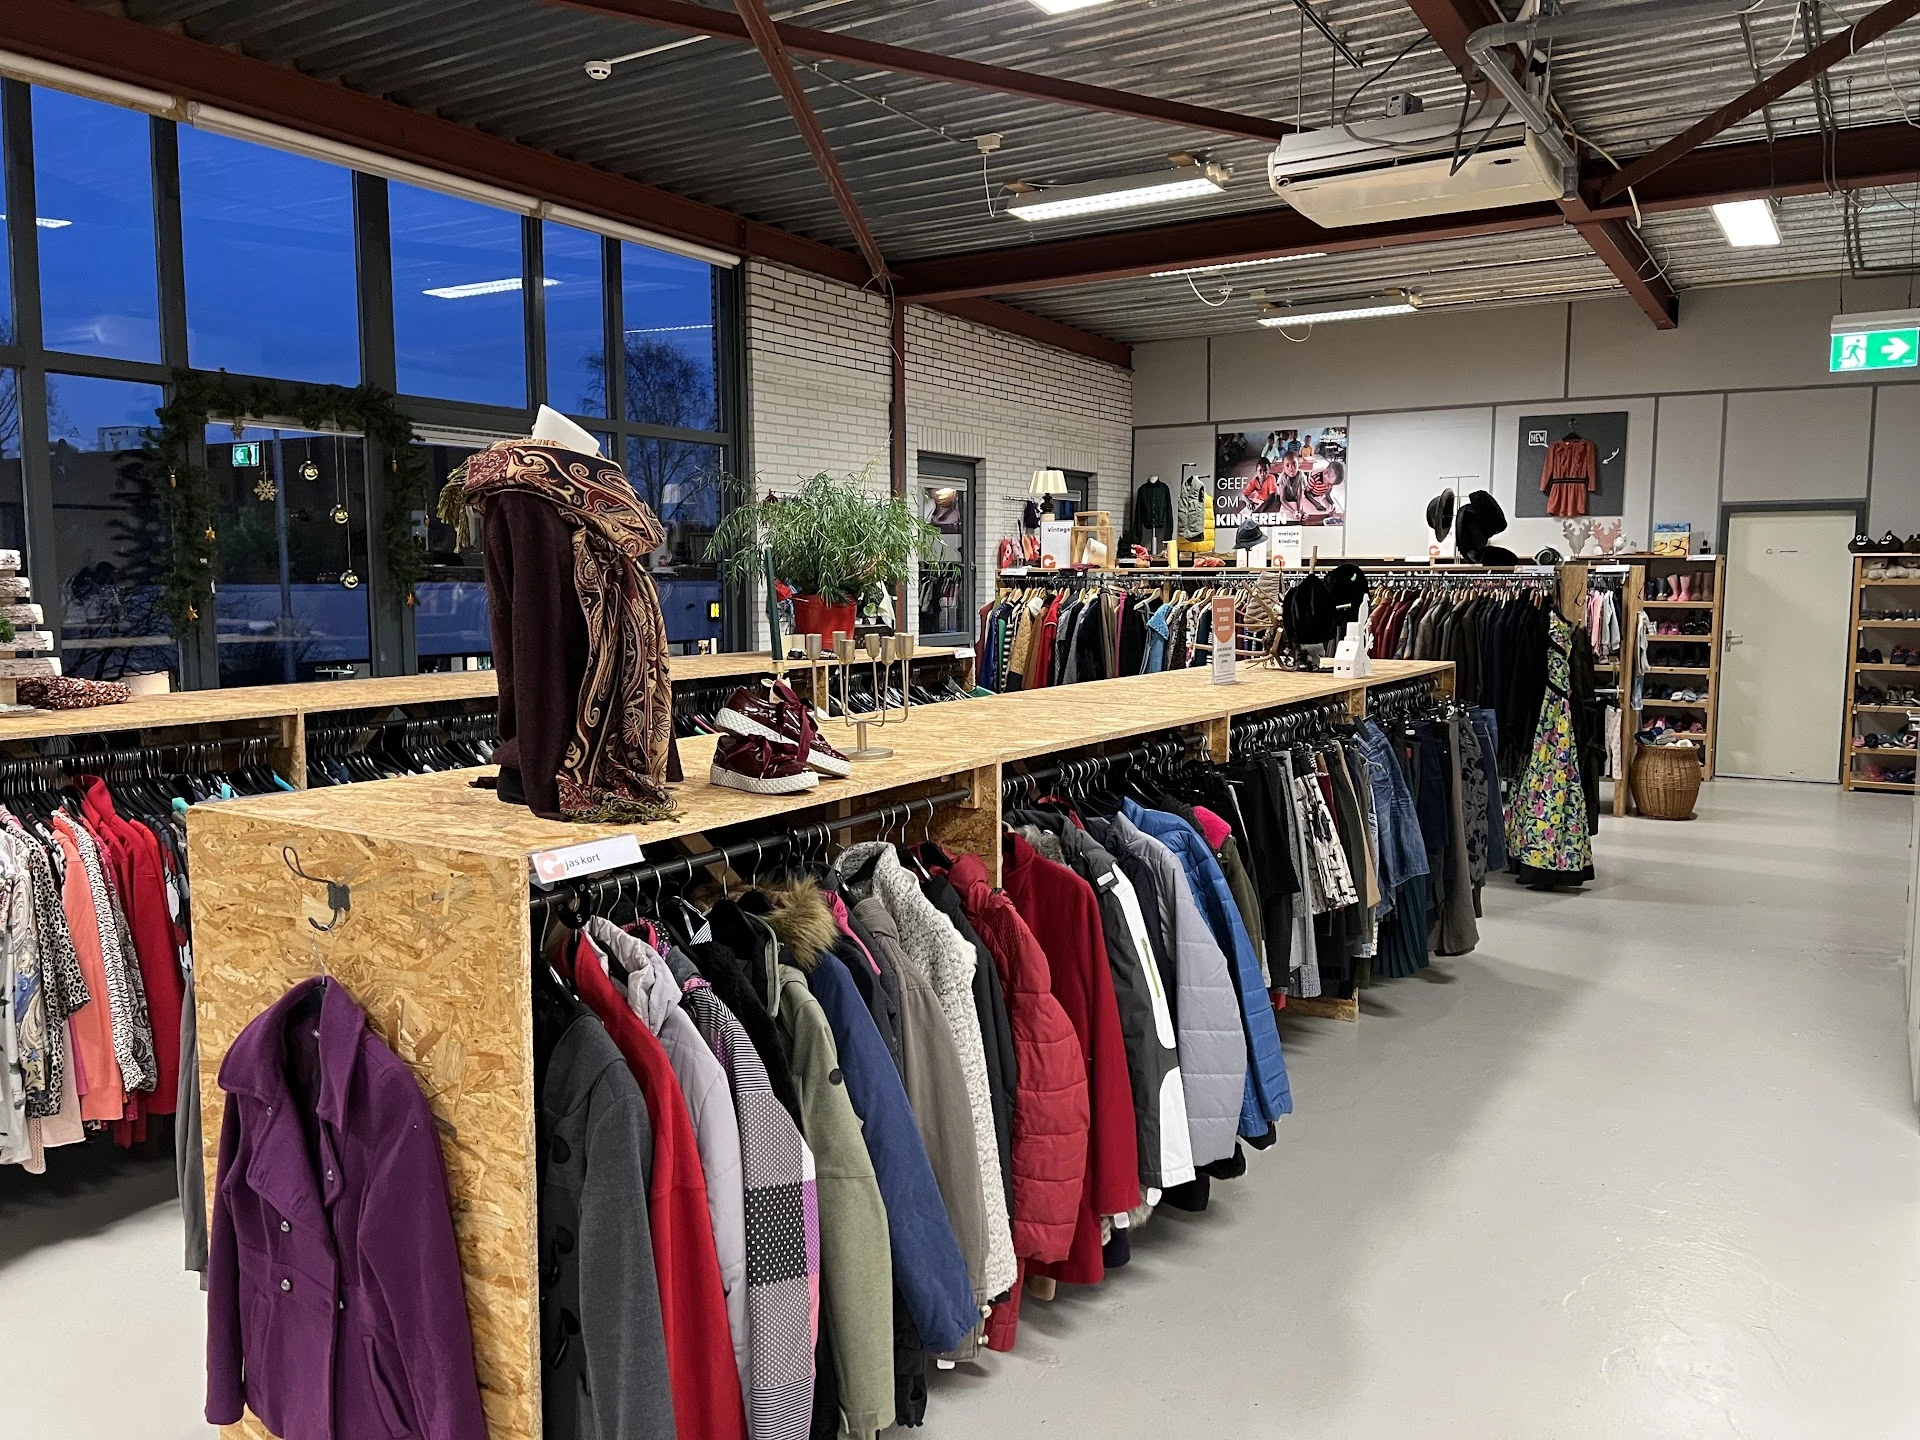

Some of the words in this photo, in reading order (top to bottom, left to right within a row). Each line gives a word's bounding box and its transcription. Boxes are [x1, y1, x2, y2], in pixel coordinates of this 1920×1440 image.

[1530, 433, 1545, 443] NEW
[1217, 477, 1248, 490] GEEF
[1217, 496, 1239, 508] OM
[565, 859, 579, 870] jas
[580, 853, 600, 864] kort
